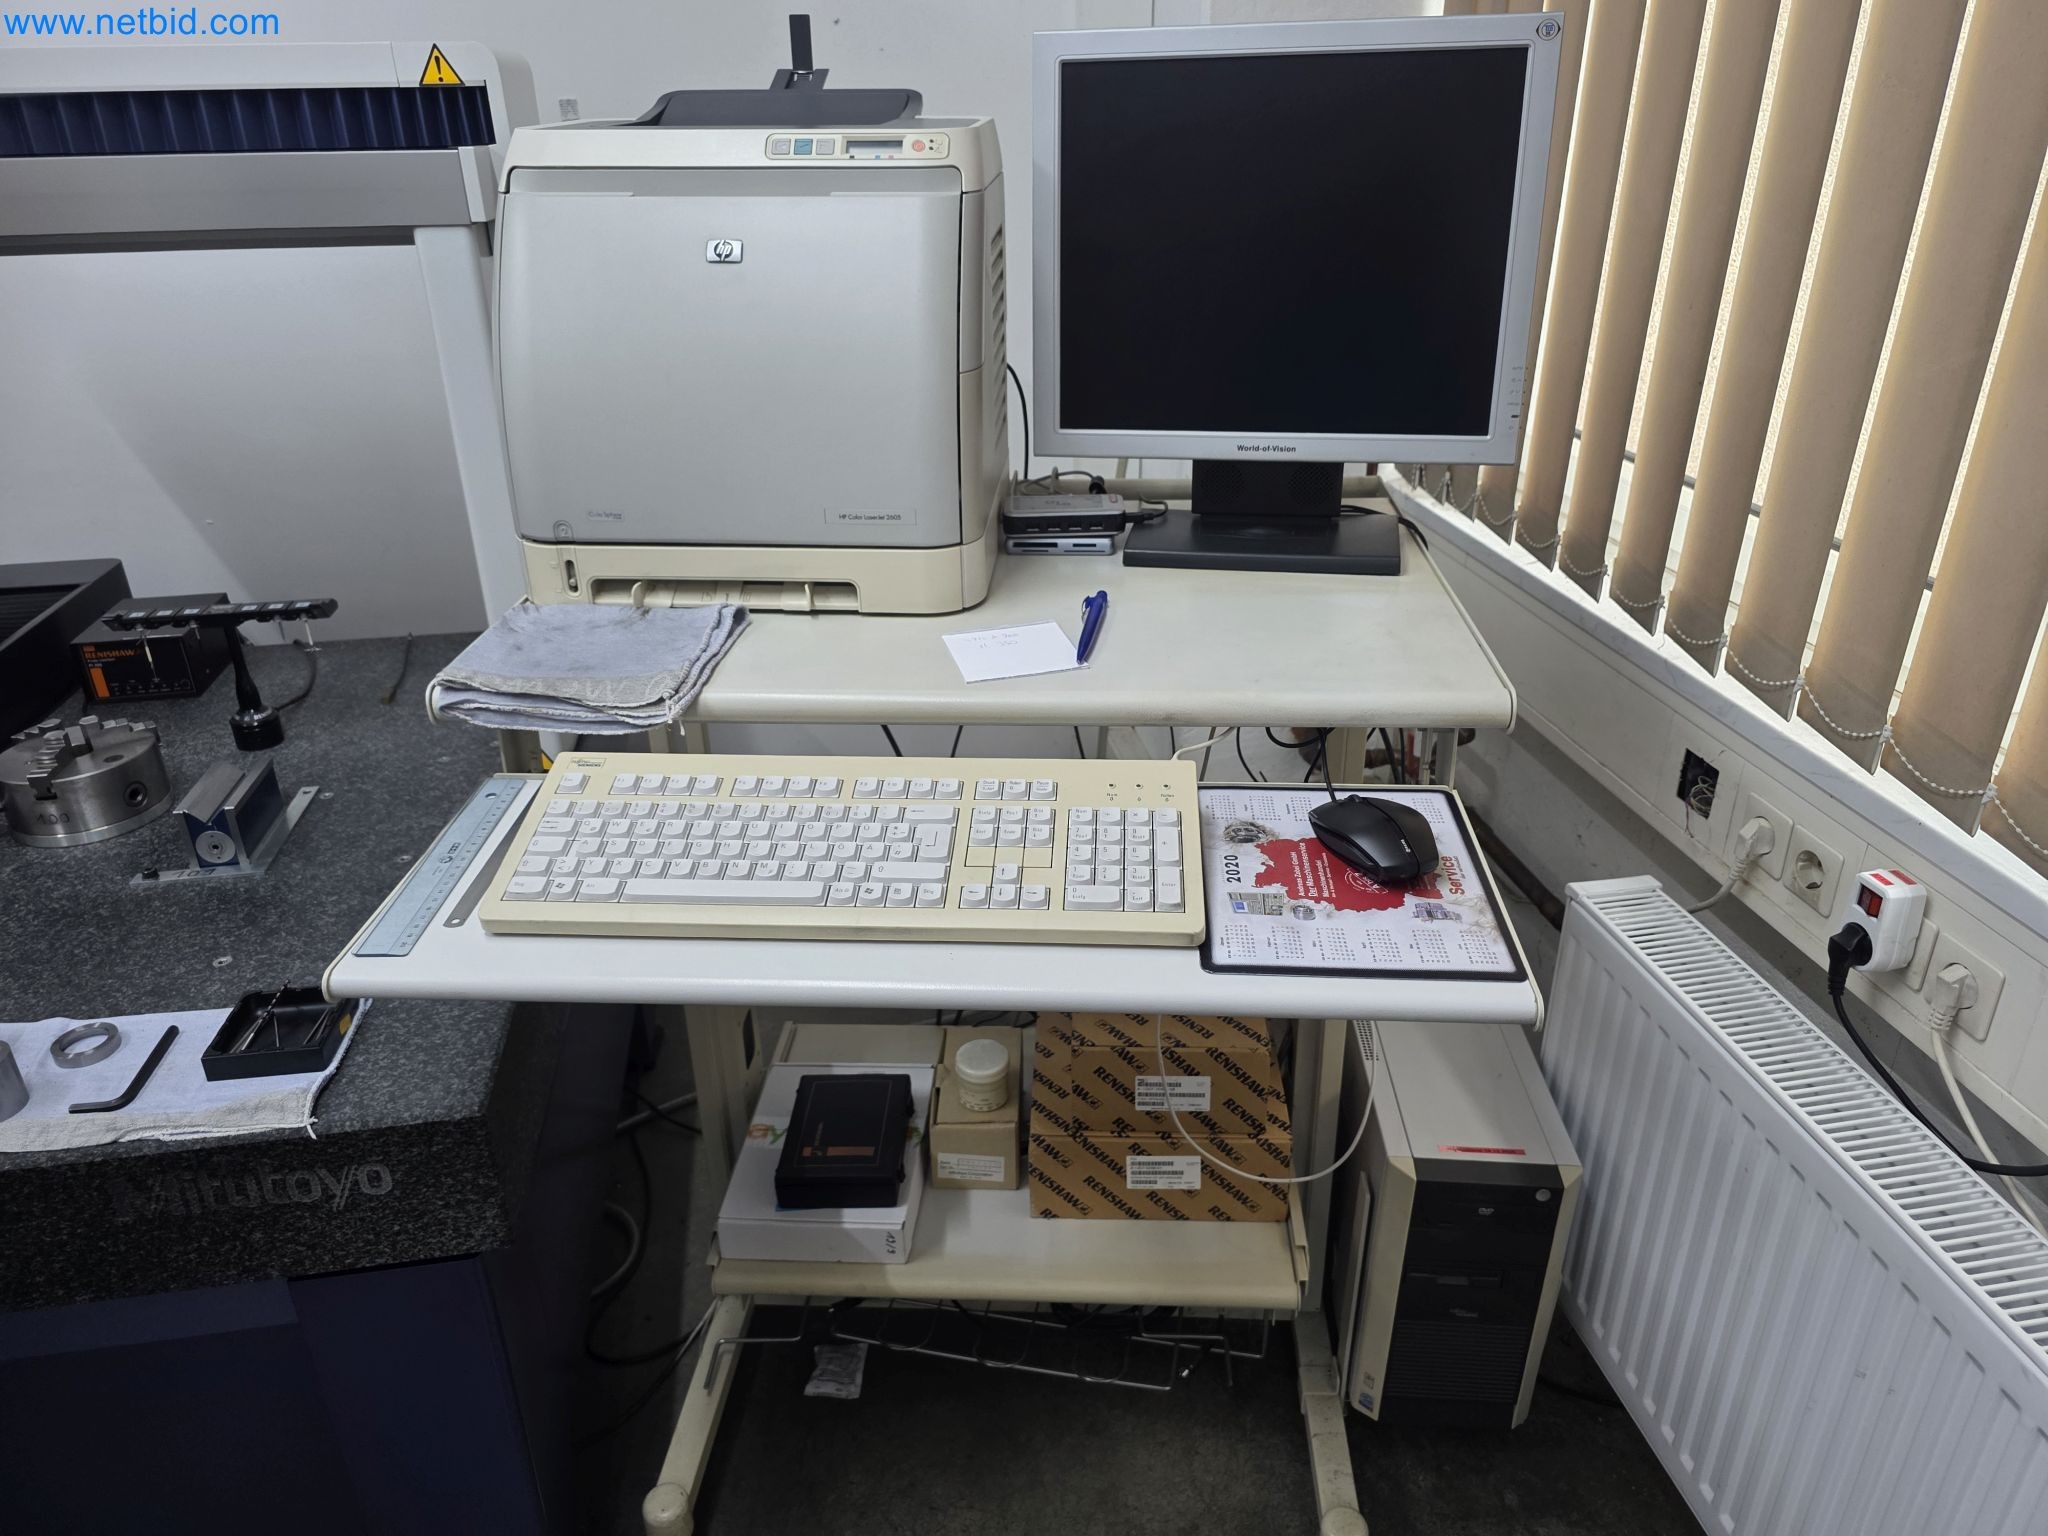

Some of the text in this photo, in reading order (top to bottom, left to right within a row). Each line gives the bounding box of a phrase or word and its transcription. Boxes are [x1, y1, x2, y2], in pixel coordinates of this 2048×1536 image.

[1236, 444, 1297, 453] World-of-Vision
[1224, 854, 1242, 884] 2020
[1299, 842, 1318, 898] Der Maschinenservice
[1441, 855, 1466, 896] Service
[1204, 1046, 1269, 1101] RENISHAW
